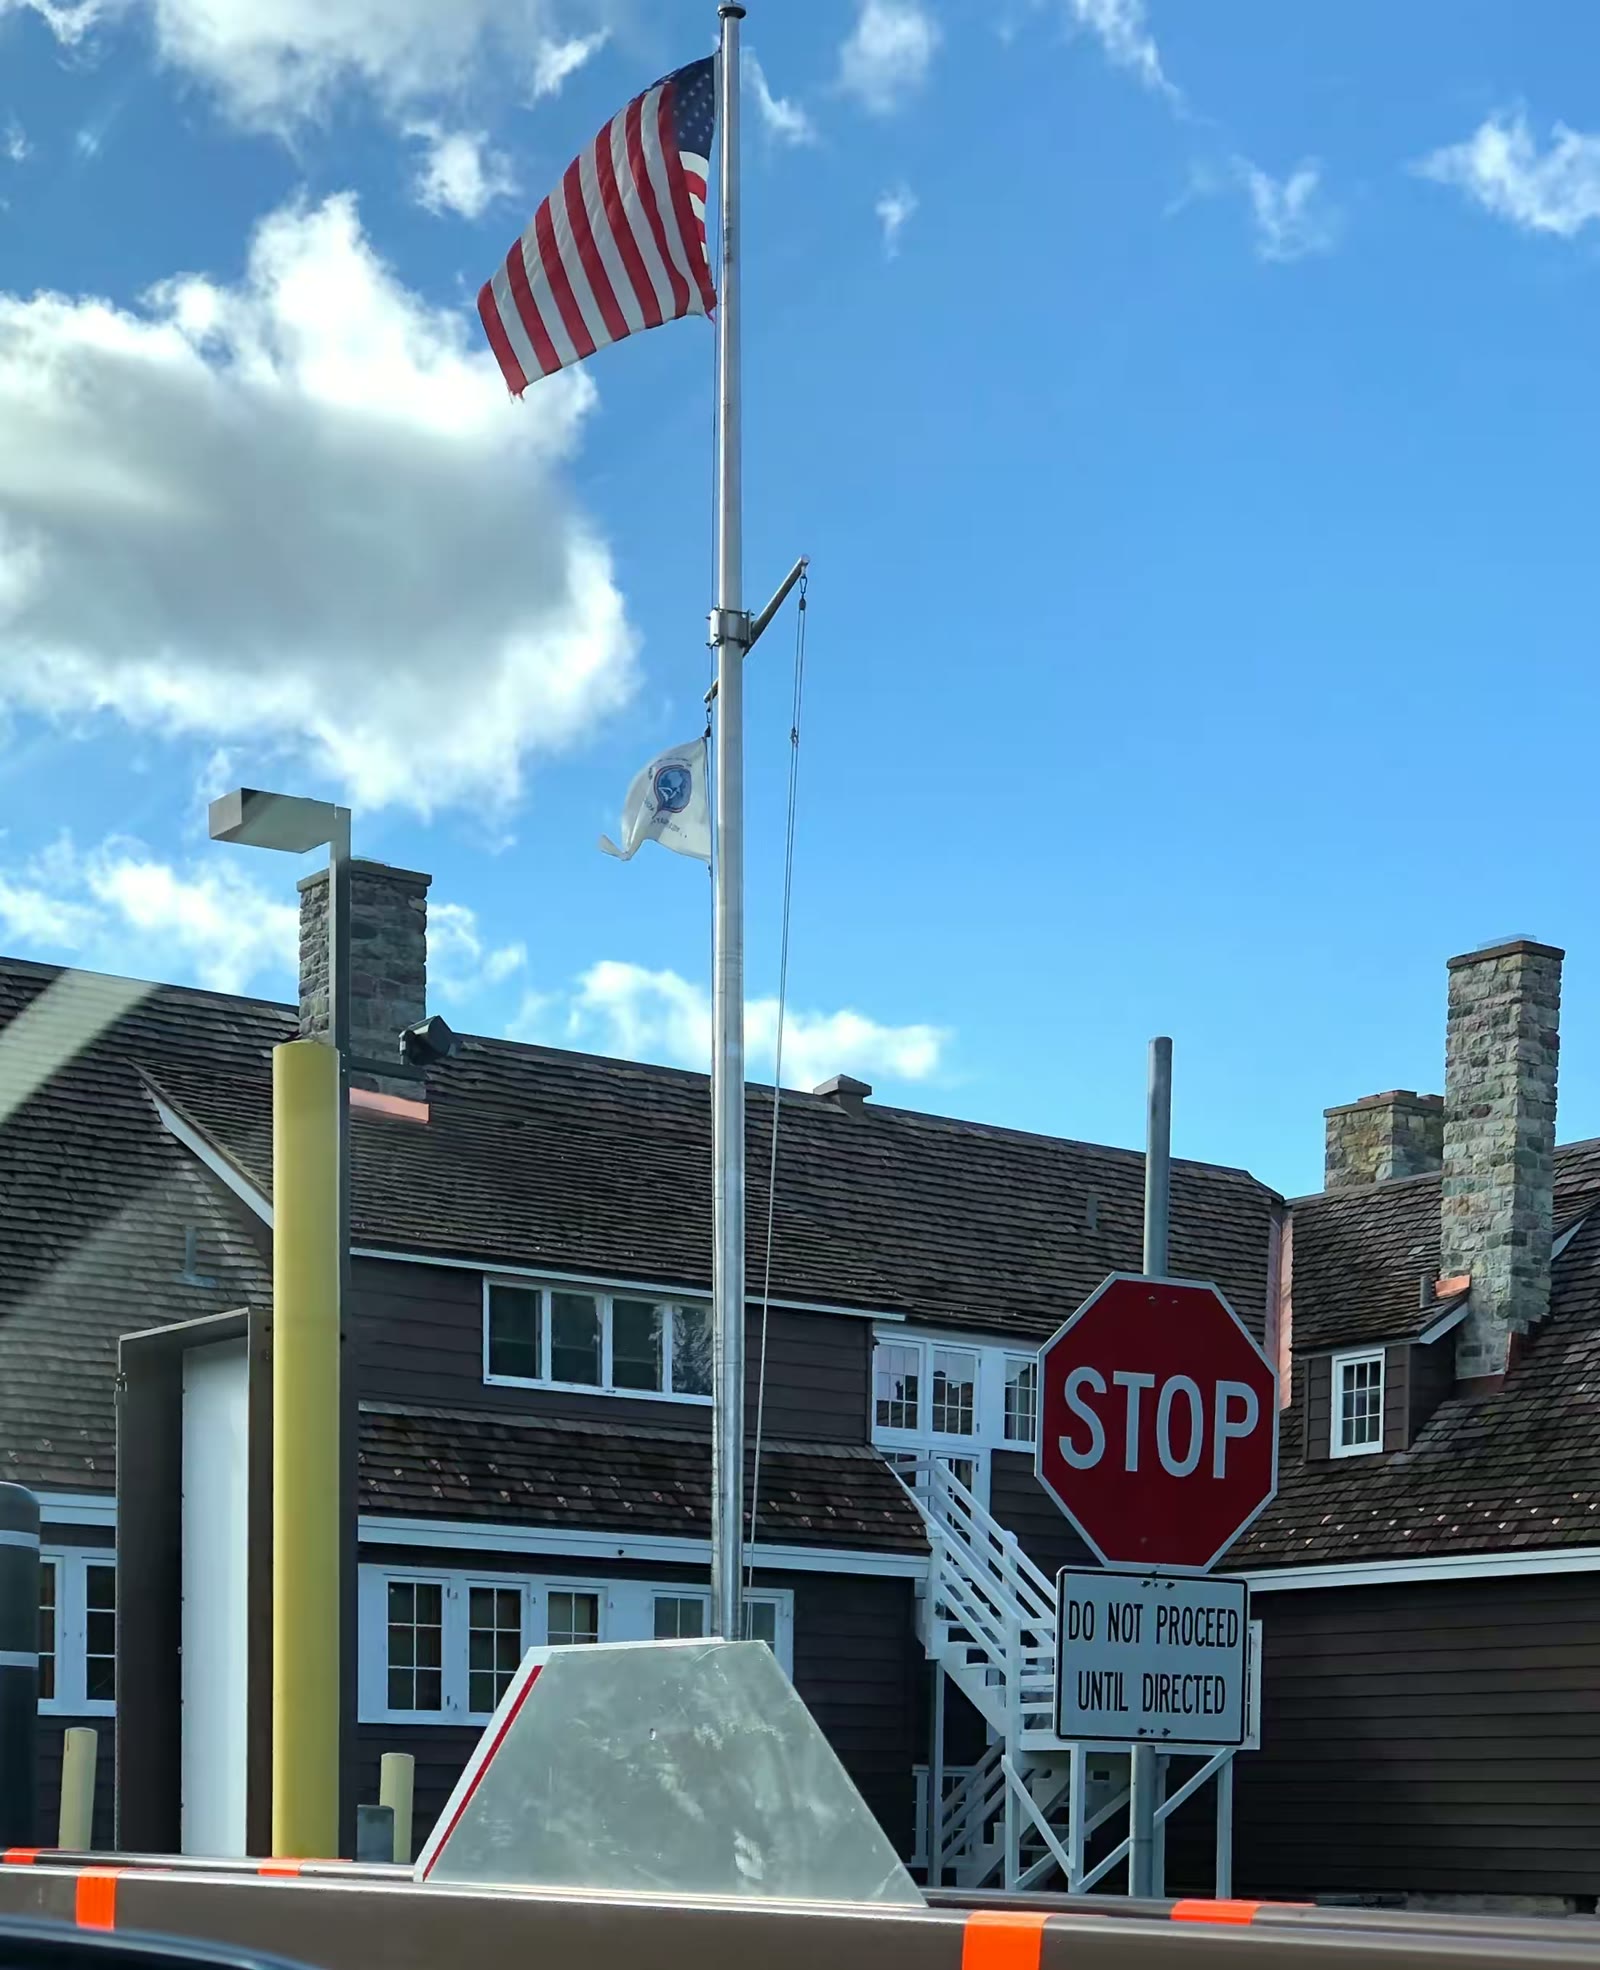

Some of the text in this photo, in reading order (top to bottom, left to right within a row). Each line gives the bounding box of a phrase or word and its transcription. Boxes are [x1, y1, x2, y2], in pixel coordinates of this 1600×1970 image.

[1059, 1367, 1259, 1479] STOP
[1069, 1600, 1239, 1648] DO NOT PROCEED
[1078, 1671, 1226, 1714] UNTIL DIRECTED
